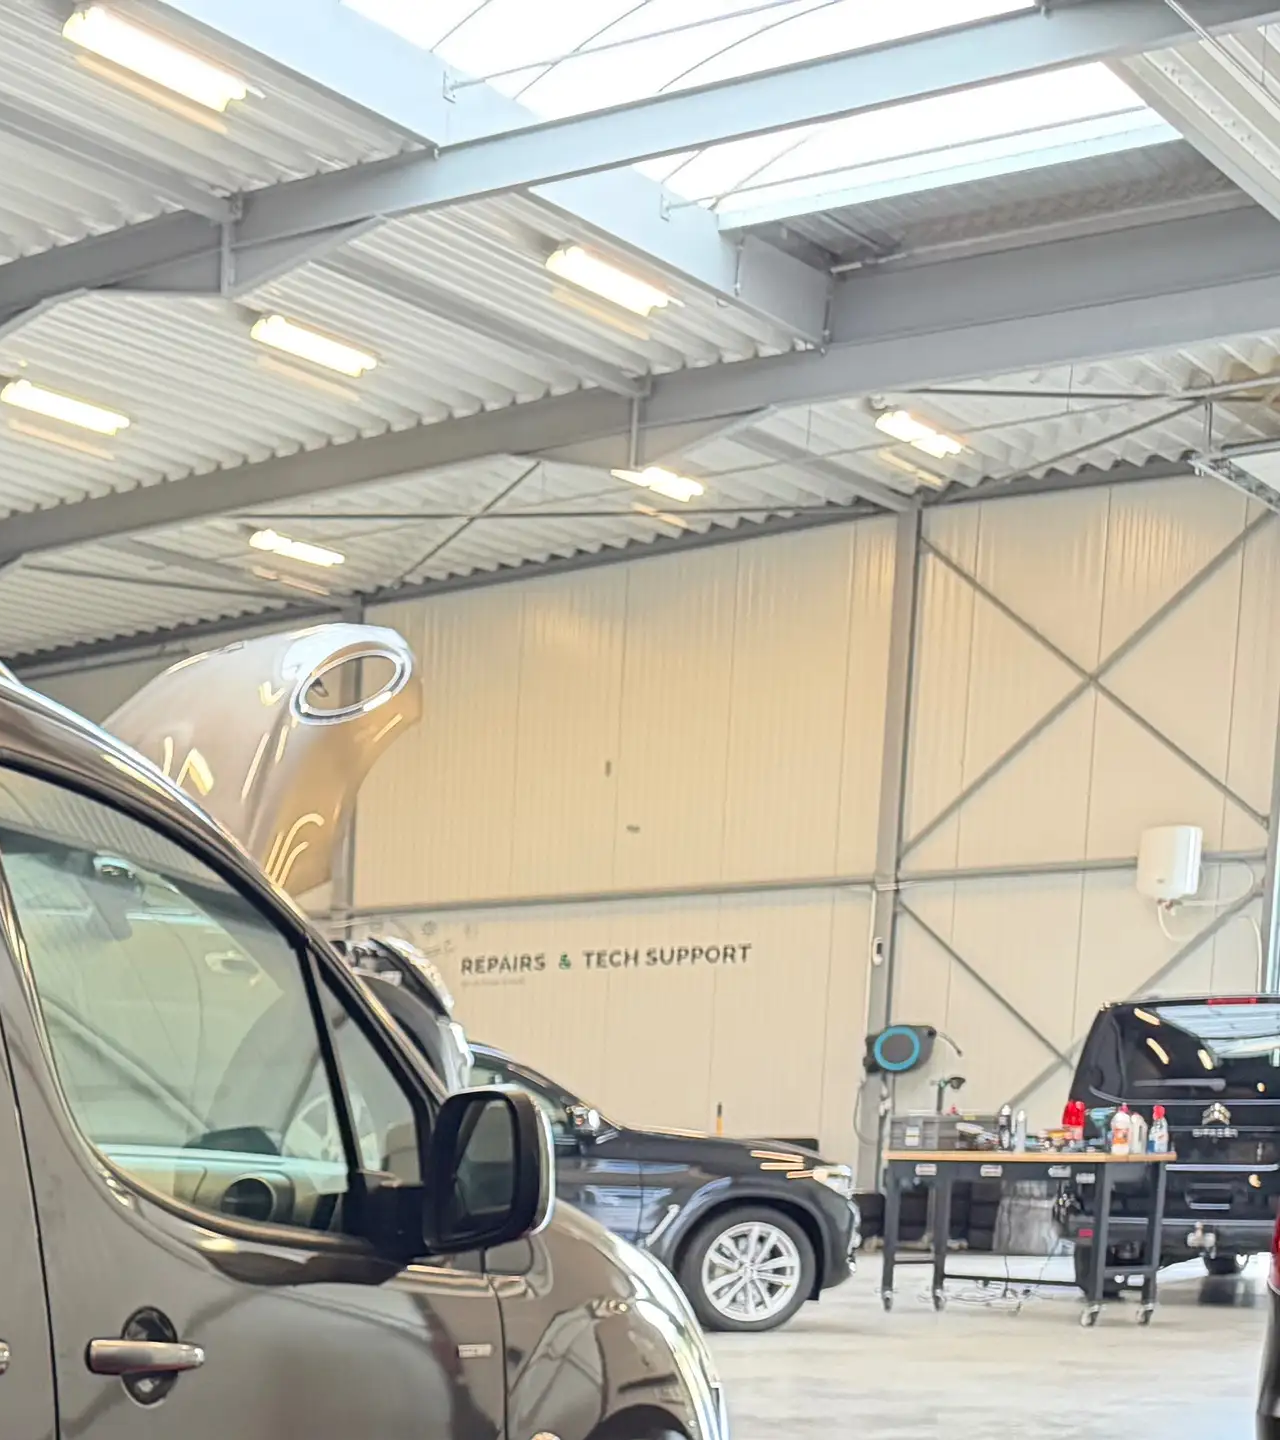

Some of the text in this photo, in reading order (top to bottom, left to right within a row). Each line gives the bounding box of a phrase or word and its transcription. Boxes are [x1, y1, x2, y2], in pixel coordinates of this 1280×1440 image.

[460, 944, 752, 976] REPAIRS & TECH SUPPORT
